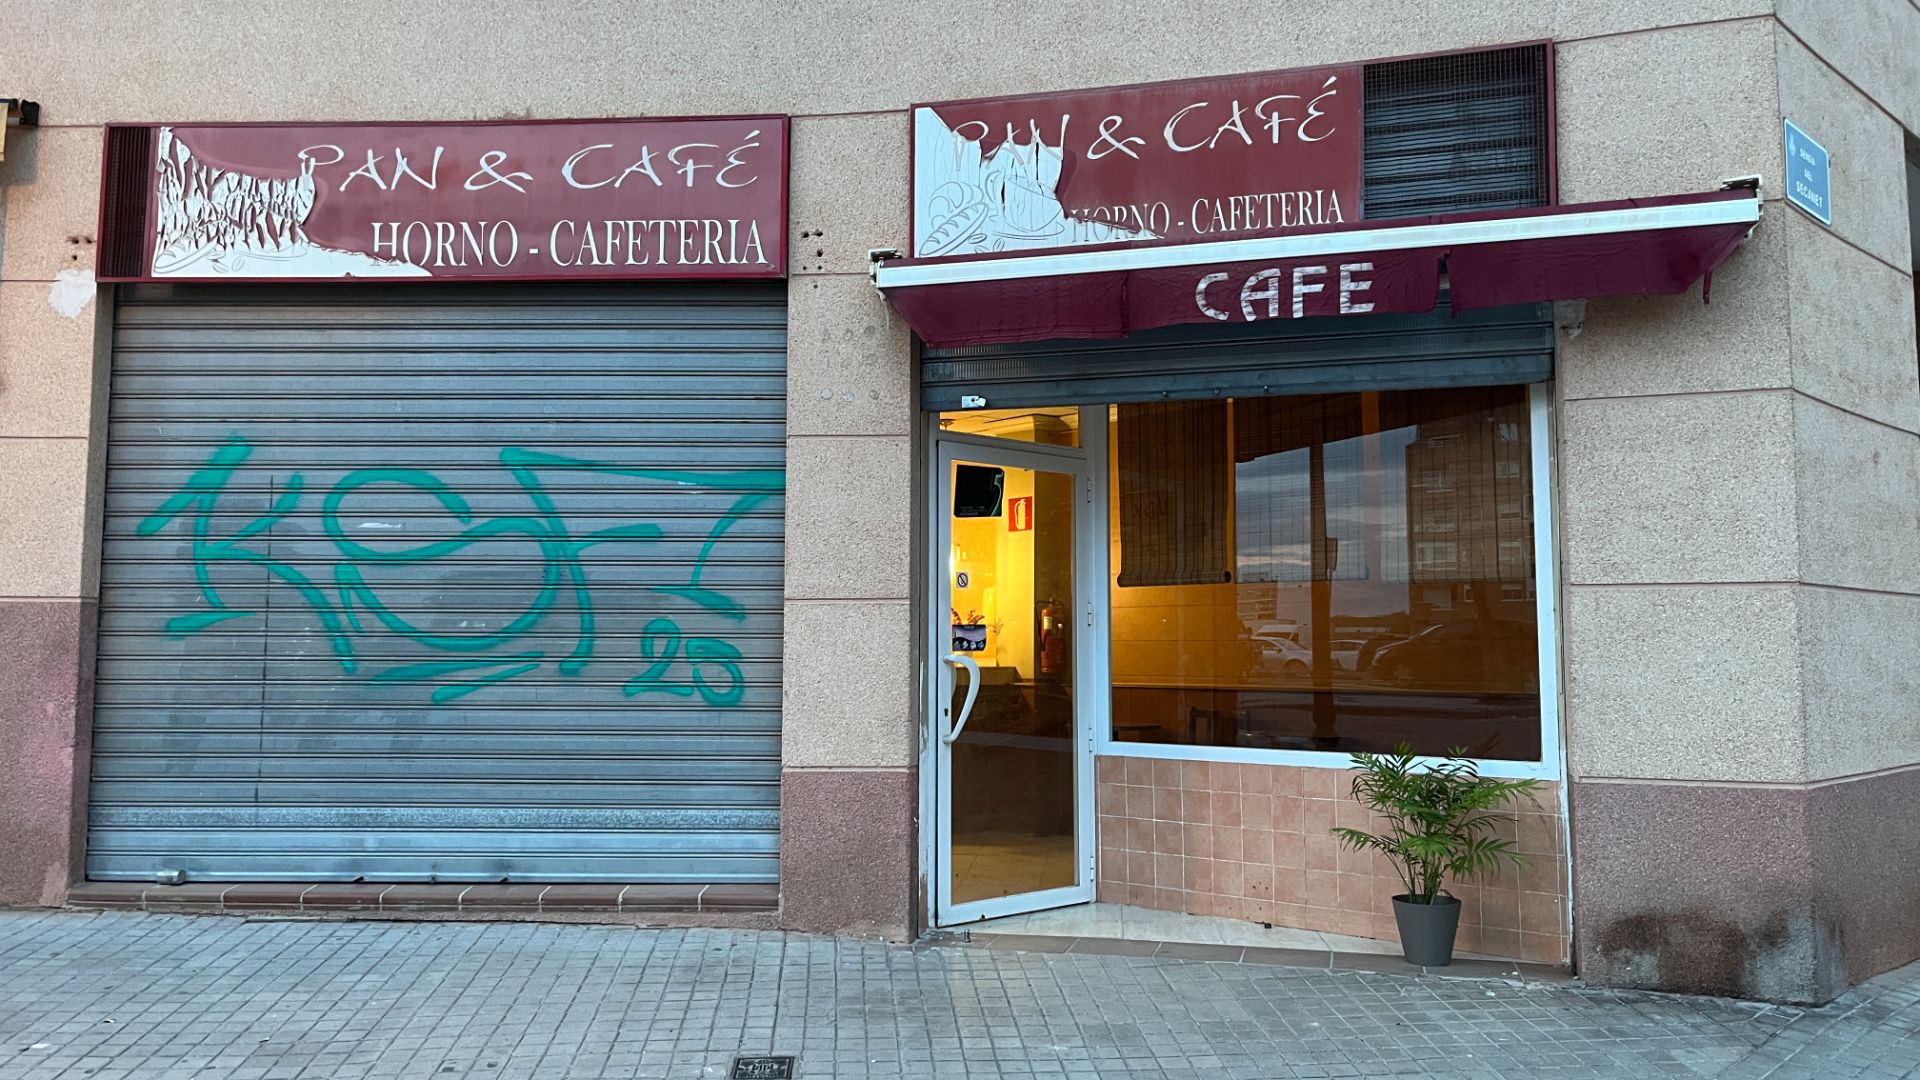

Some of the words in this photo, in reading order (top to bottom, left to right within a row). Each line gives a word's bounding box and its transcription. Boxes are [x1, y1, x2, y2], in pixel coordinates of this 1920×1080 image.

[1087, 115, 1146, 160] &
[1163, 76, 1339, 152] CAFÉ
[298, 144, 444, 192] PAN
[464, 150, 533, 192] &
[561, 130, 761, 190] CAFÉ
[1070, 201, 1170, 243] HORNO
[1190, 188, 1344, 235] CAFETERIA
[1795, 180, 1823, 208] SECANET
[372, 220, 519, 269] HORNO
[550, 218, 769, 267] CAFETERIA
[1195, 262, 1376, 322] CAFE
